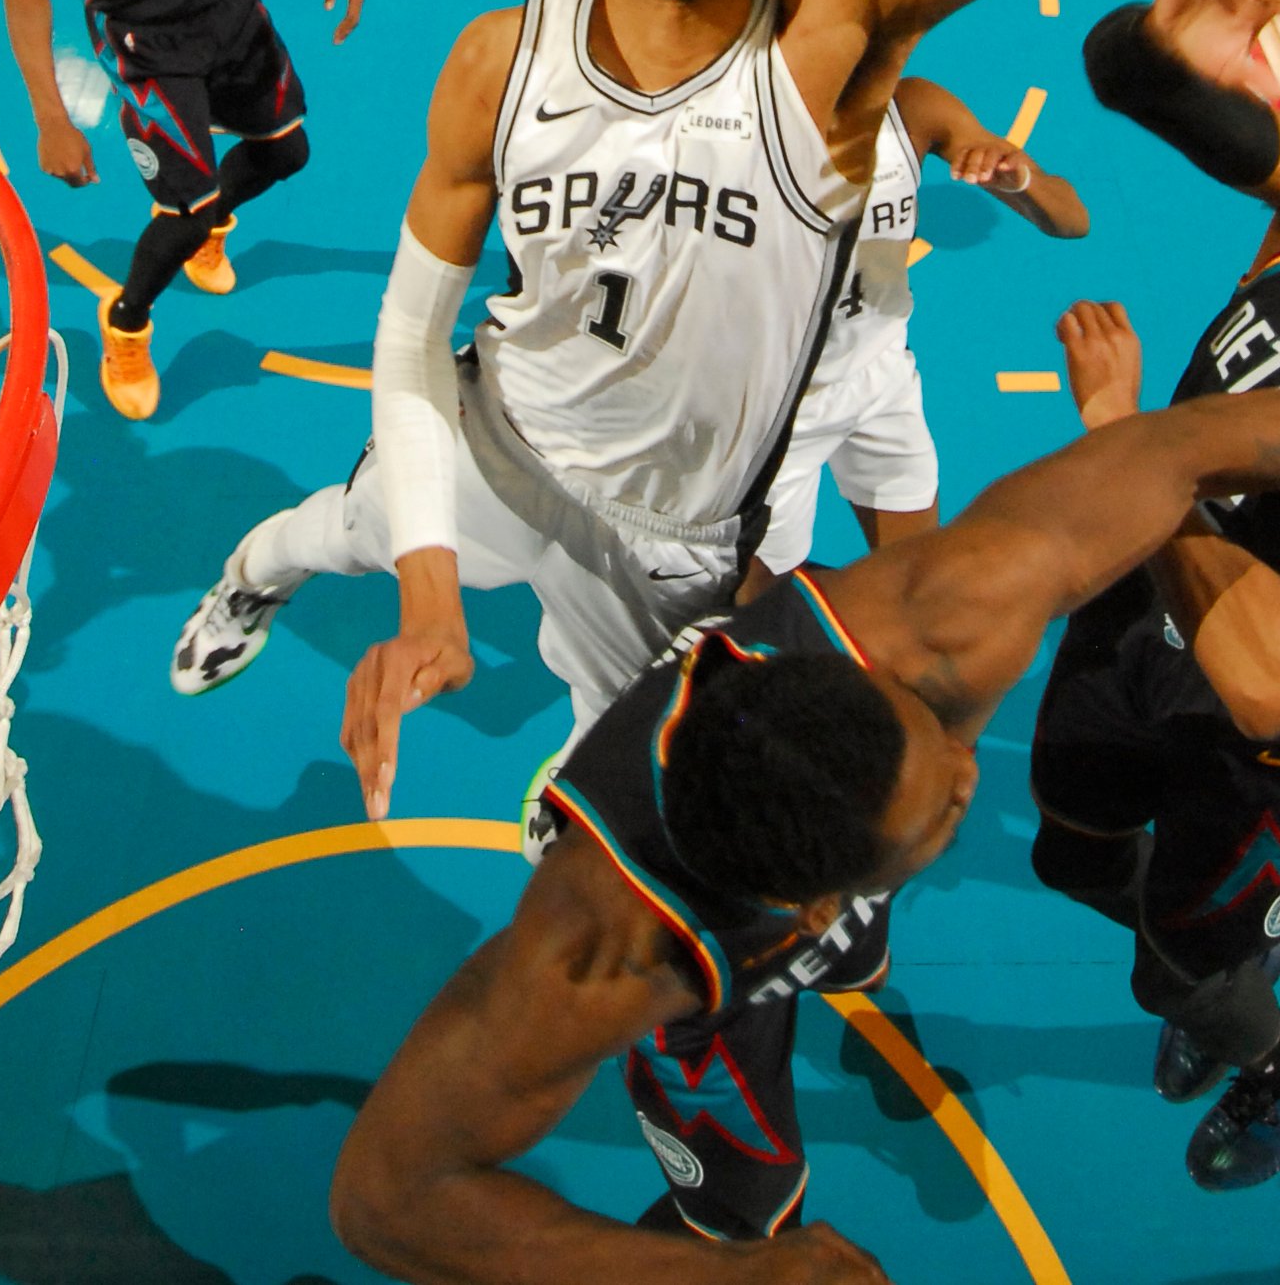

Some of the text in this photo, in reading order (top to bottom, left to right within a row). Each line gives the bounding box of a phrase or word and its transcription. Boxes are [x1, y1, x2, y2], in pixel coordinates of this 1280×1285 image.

[688, 112, 744, 133] LEDGER
[511, 171, 760, 255] SPURS
[584, 269, 635, 356] 1
